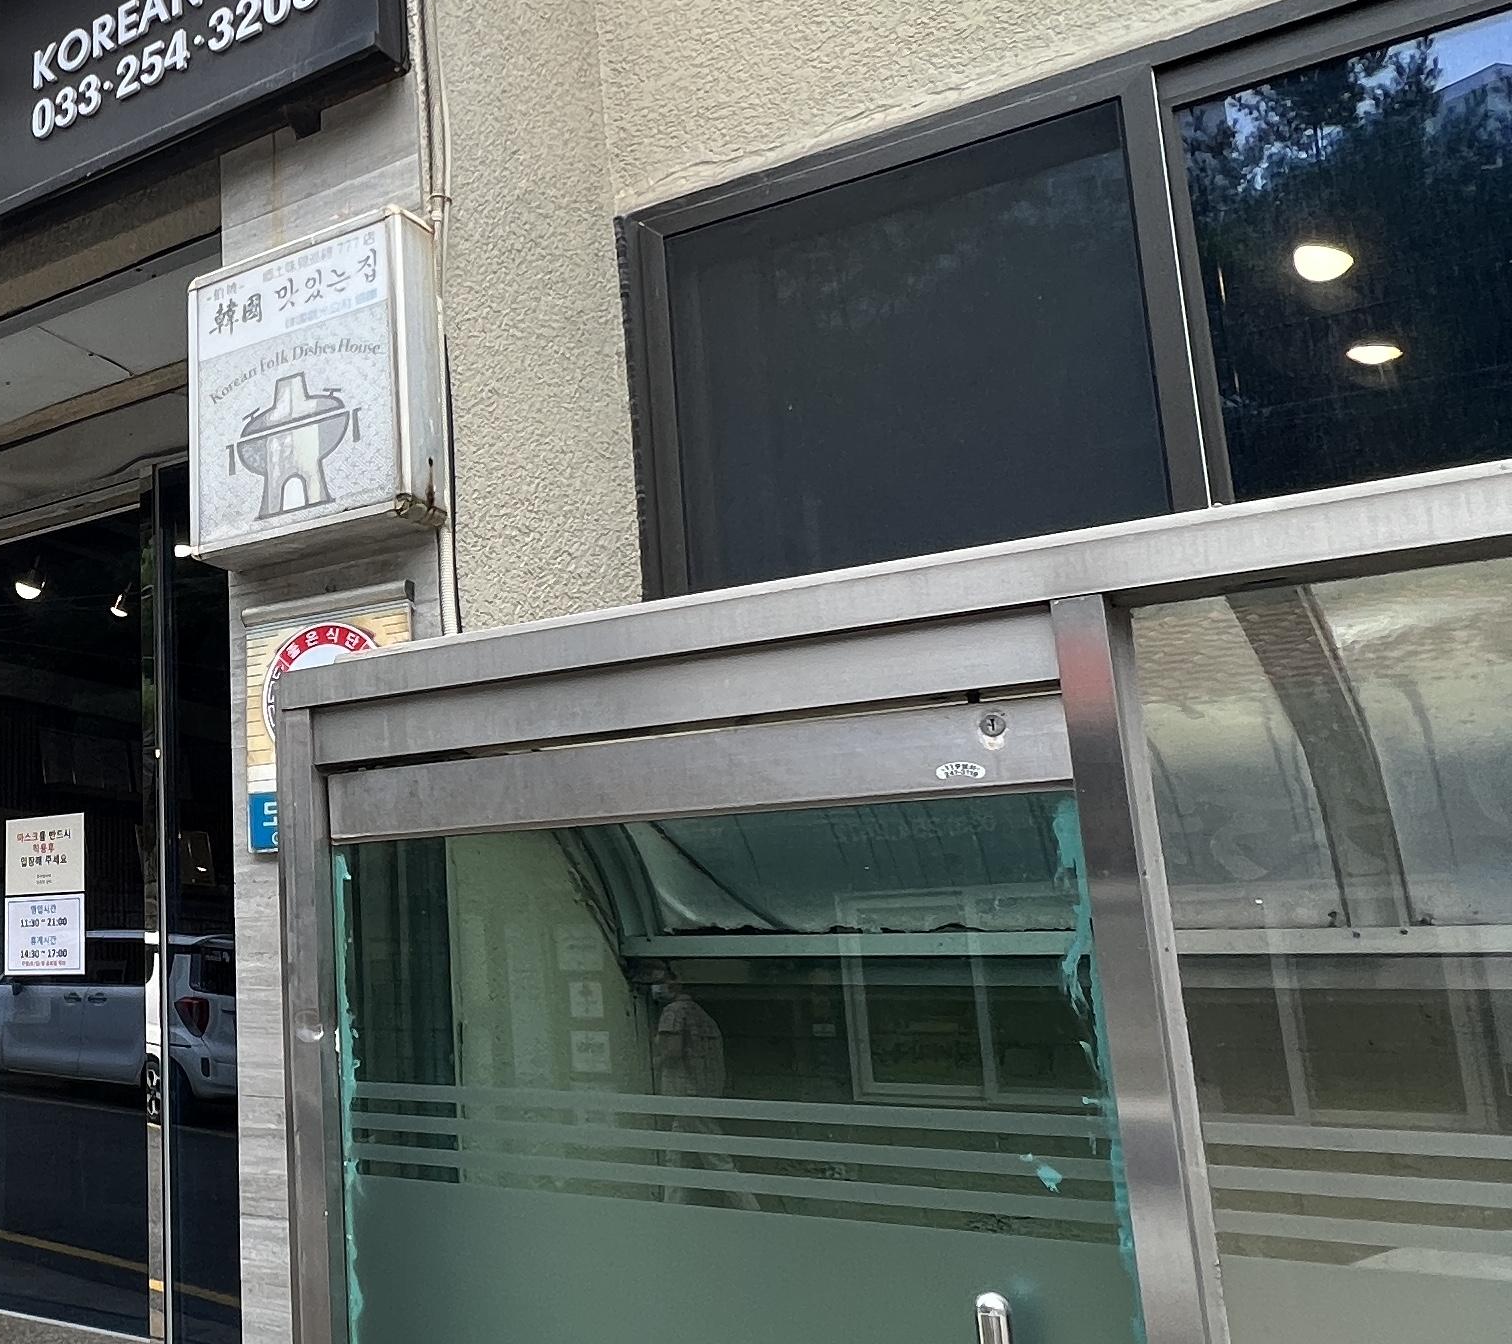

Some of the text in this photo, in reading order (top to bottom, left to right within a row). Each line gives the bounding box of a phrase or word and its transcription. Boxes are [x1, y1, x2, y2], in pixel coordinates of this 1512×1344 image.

[209, 292, 262, 336] 韓國
[273, 269, 351, 311] 맛있는
[356, 248, 377, 283] 집
[208, 368, 257, 405] Korean
[292, 339, 336, 362] Dishes
[337, 337, 381, 356] House
[48, 828, 71, 840] 반드시
[20, 918, 39, 928] 11:30
[47, 917, 68, 927] 21:00
[20, 949, 39, 959] 14:30
[47, 948, 68, 958] 17:00
